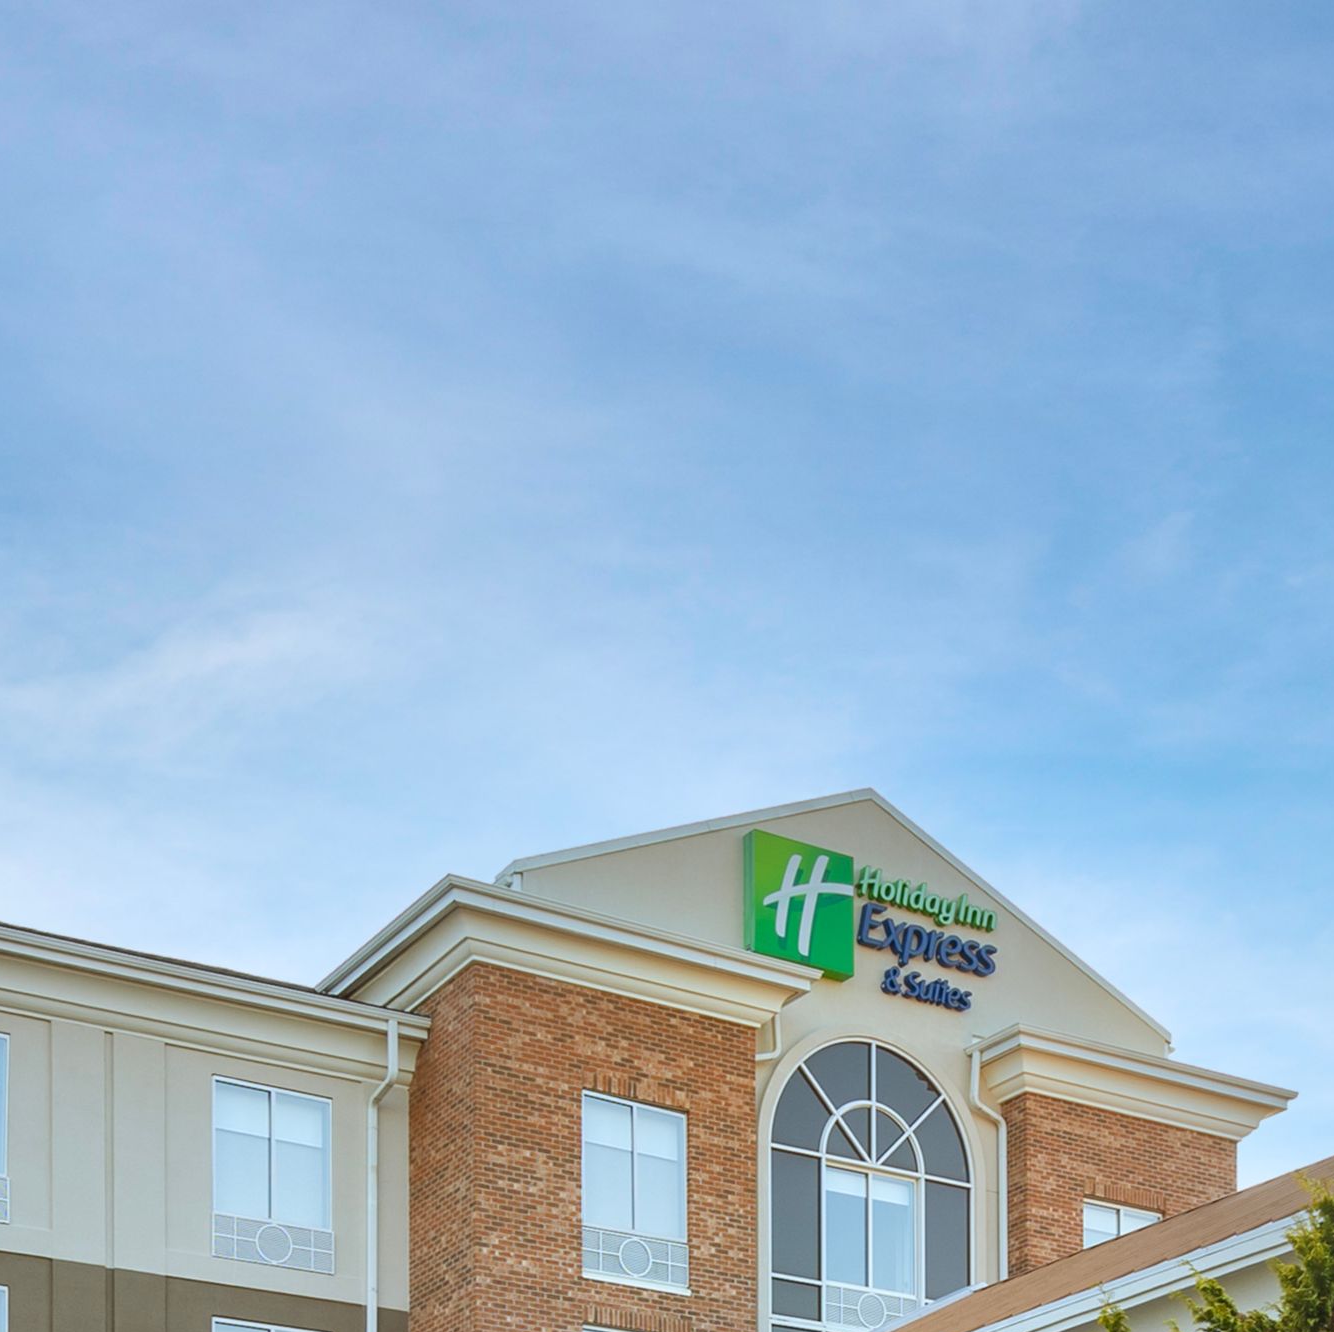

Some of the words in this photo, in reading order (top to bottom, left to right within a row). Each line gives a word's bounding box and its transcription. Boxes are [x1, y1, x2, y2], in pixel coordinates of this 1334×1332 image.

[857, 866, 956, 926] Holiday
[955, 893, 997, 932] Inn
[857, 902, 997, 977] Express
[880, 966, 902, 995] &
[902, 971, 972, 1011] Suites
